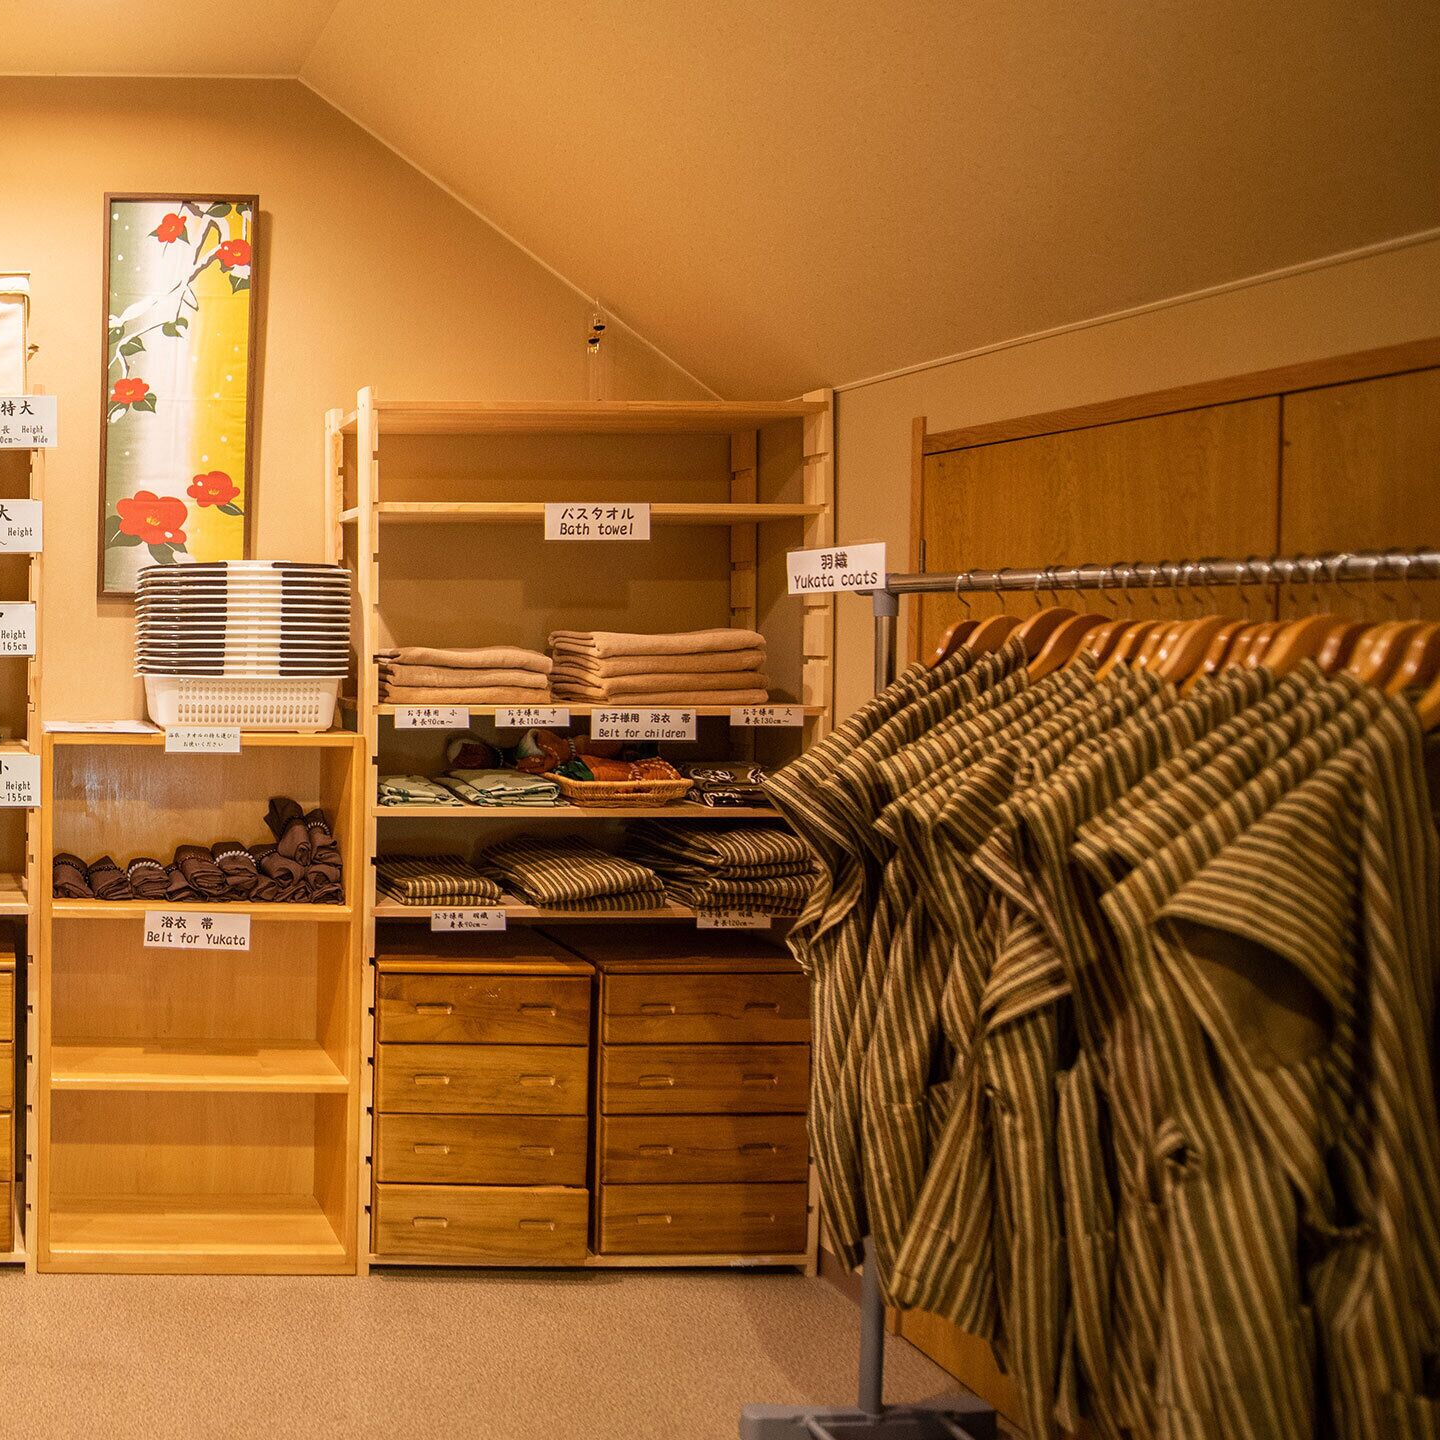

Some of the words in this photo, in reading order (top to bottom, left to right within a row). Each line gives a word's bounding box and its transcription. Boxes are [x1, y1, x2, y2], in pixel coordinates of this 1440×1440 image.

[0, 400, 34, 416] 特大
[21, 425, 44, 434] Height
[561, 507, 634, 520] バスタオル
[7, 527, 33, 537] Height
[560, 523, 590, 535] Bath
[598, 523, 633, 535] towel
[820, 551, 848, 570] 羽織
[794, 574, 834, 589] Yukata
[841, 570, 878, 586] coats
[1, 629, 26, 640] Height
[407, 709, 439, 717] お子様用
[449, 709, 457, 717] 小
[507, 708, 540, 717] お子様用
[550, 708, 557, 716] 中
[742, 708, 774, 716] お子様用
[784, 708, 792, 716] 大
[600, 713, 640, 723] お子様用
[650, 713, 671, 723] 浴衣
[681, 713, 691, 723] 帯
[599, 728, 619, 738] Belt
[625, 728, 640, 738] for
[645, 729, 686, 738] children
[5, 781, 31, 791] Height
[161, 916, 187, 929] 浴衣
[201, 917, 213, 930] 帯
[147, 931, 173, 943] Belt
[180, 932, 200, 944] for
[206, 933, 246, 946] Yukata
